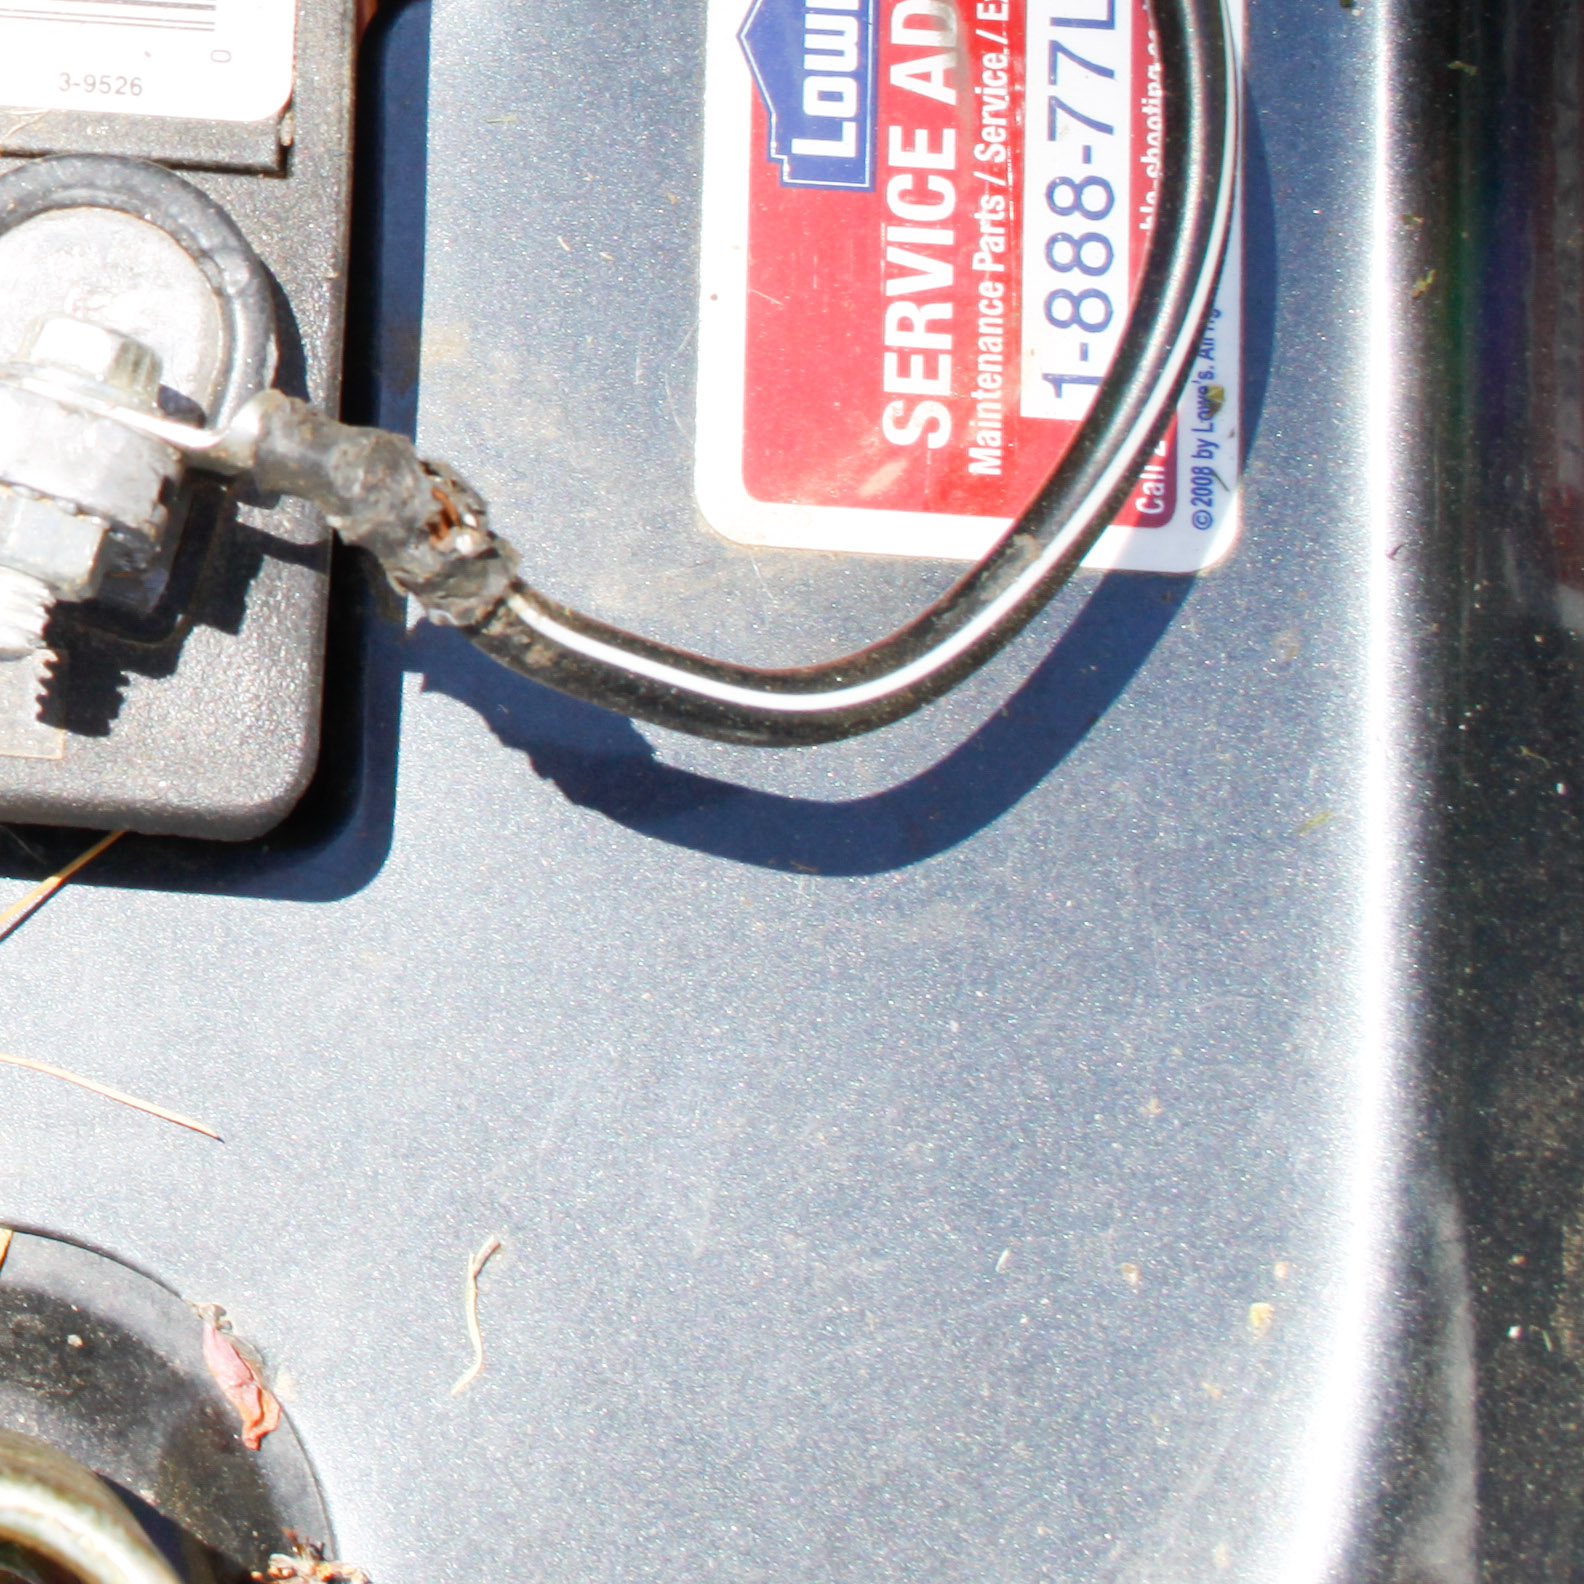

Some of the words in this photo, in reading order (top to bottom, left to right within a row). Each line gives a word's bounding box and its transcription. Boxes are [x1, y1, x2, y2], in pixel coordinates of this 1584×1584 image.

[57, 71, 143, 98] 3-9526
[974, 50, 1008, 161] Service
[972, 194, 1006, 271] Parts
[883, 126, 958, 449] SERVICE
[967, 281, 1004, 474] Maintenance
[1190, 437, 1219, 458] by
